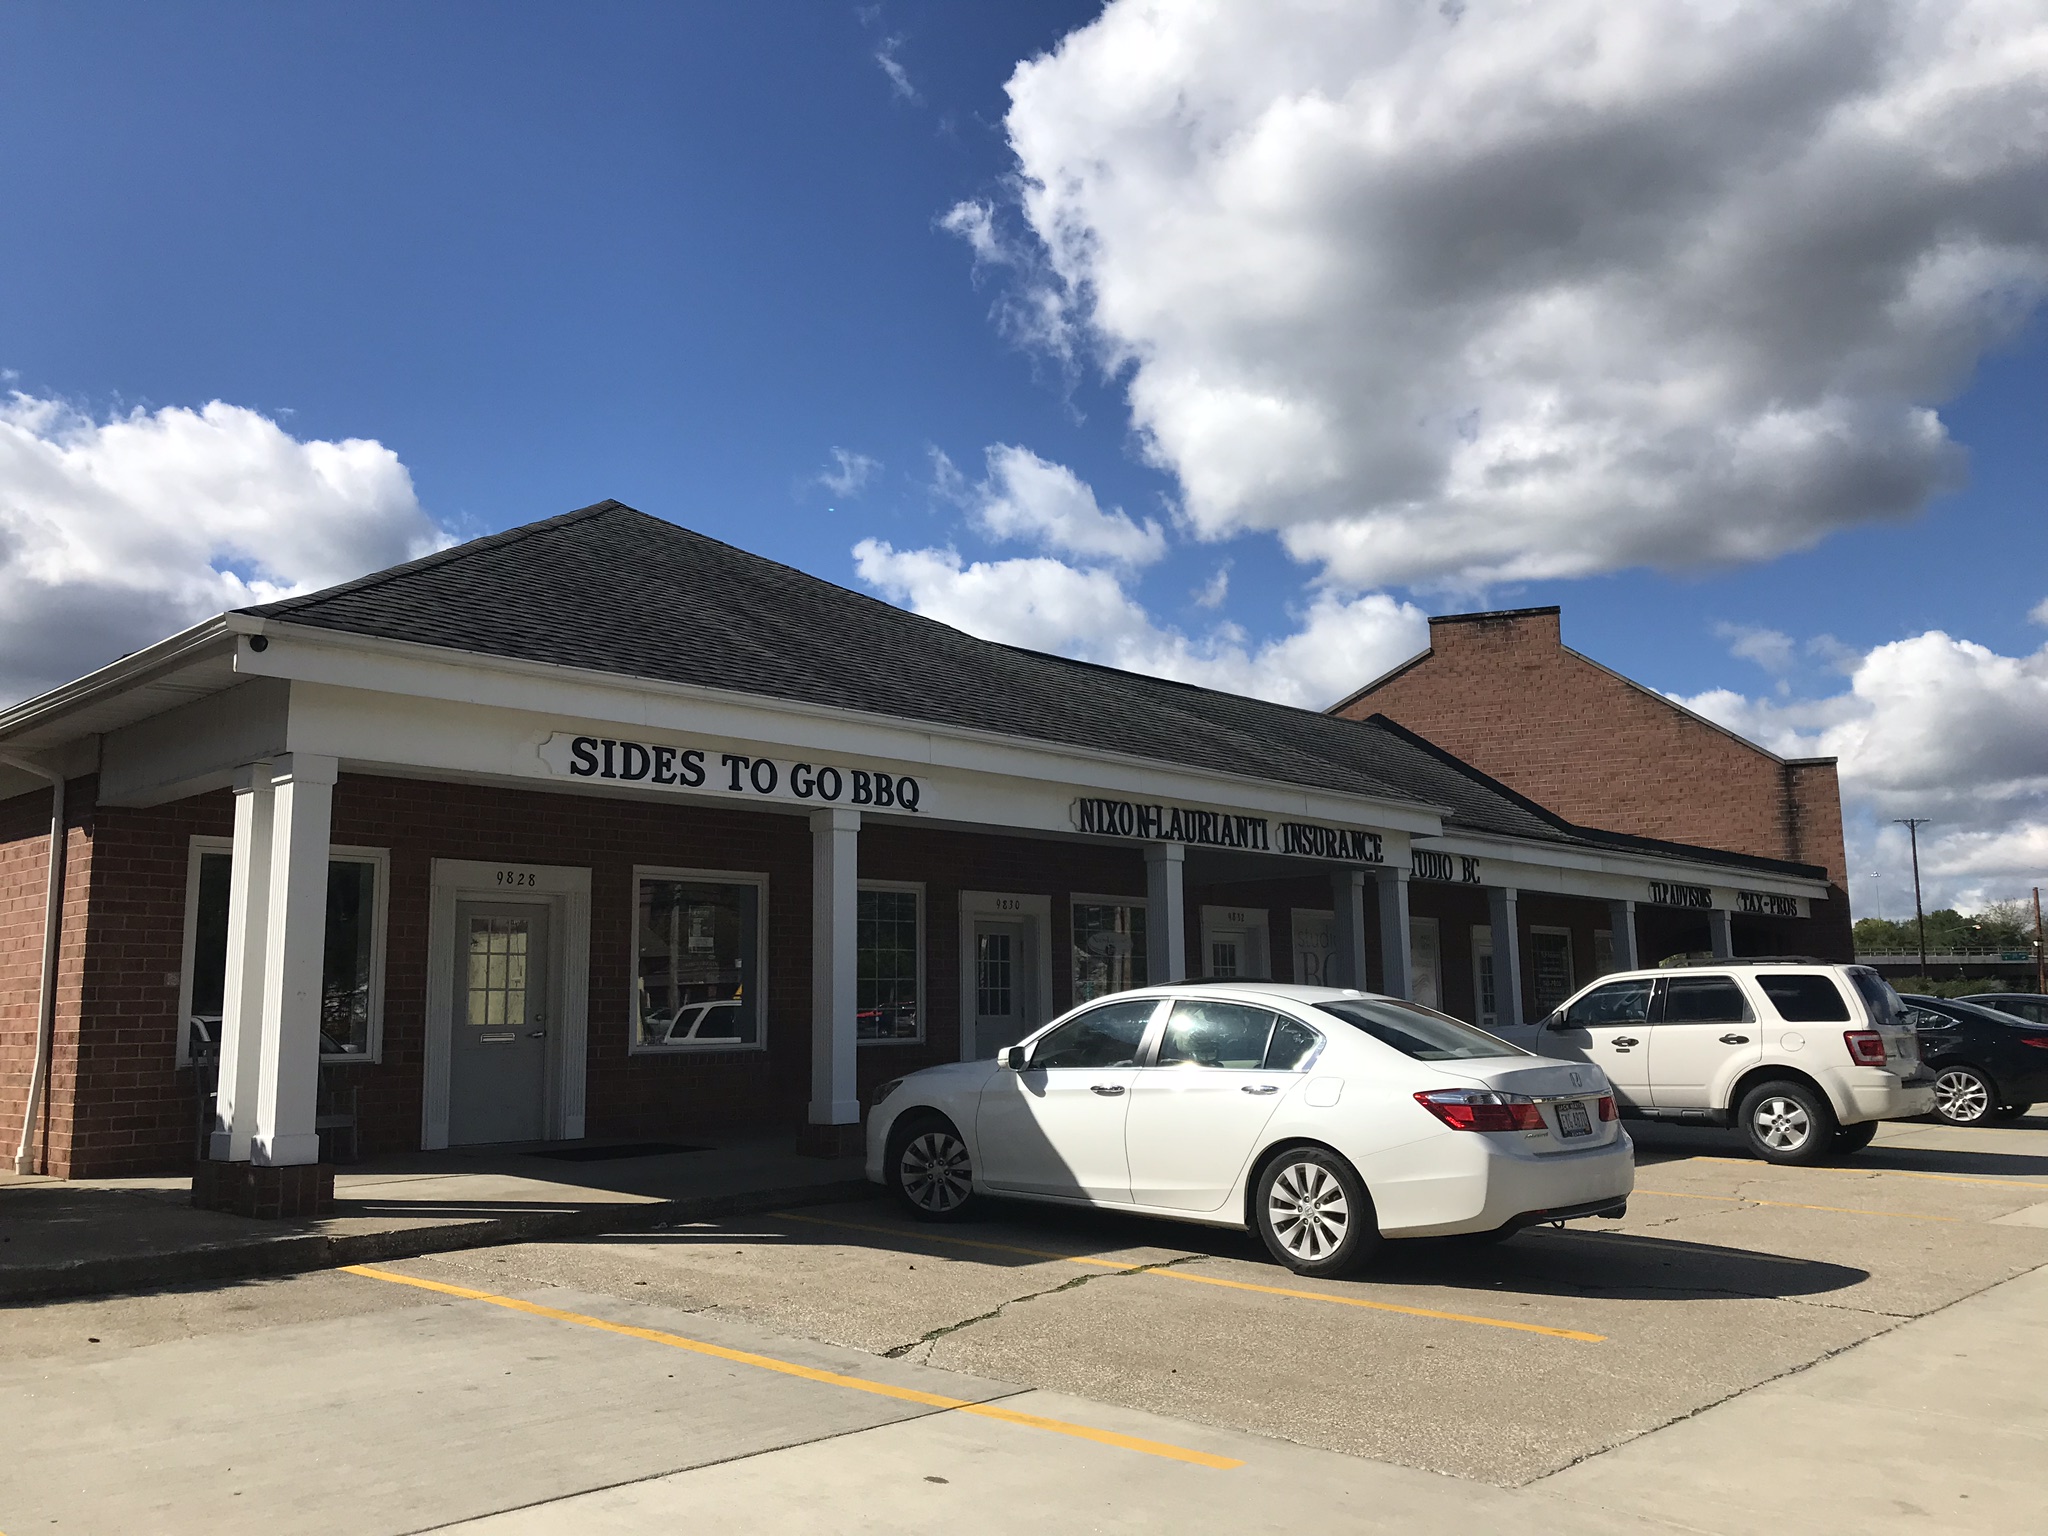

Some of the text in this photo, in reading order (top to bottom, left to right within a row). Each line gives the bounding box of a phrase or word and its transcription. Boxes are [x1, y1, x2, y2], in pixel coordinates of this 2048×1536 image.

[570, 736, 920, 813] SIDES TO GO BBQ
[1281, 822, 1384, 864] INSURANCE
[496, 870, 537, 887] 9828
[1460, 856, 1482, 885] BC
[996, 898, 1020, 910] 9830
[1669, 883, 1713, 909] ADVISORS
[1738, 891, 1798, 917] TAX-PROS
